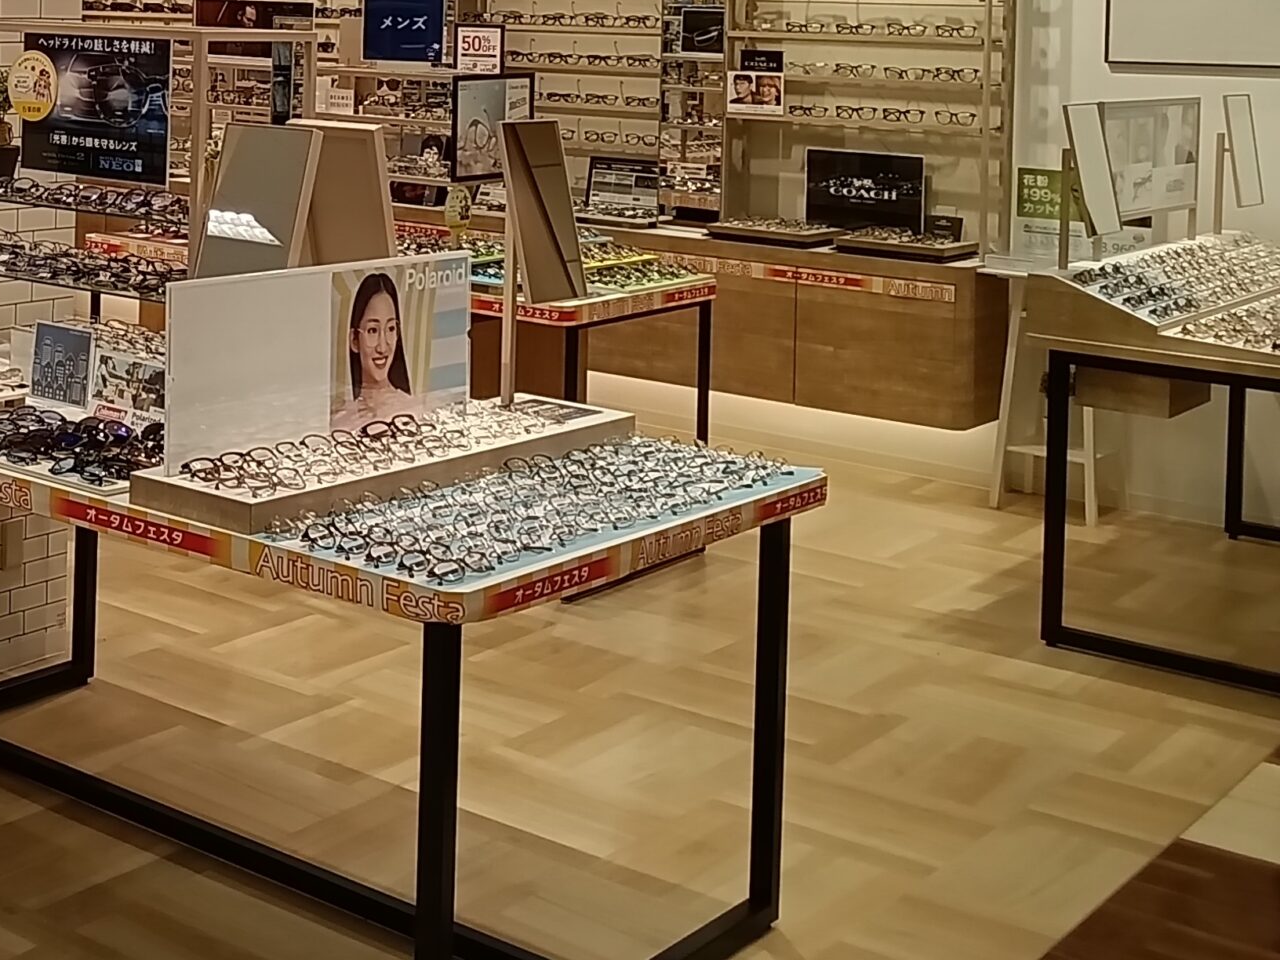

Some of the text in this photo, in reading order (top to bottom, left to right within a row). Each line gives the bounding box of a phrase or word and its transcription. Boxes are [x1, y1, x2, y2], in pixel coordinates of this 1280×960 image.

[380, 16, 428, 30] メンズ
[481, 45, 497, 53] OFF
[99, 159, 134, 171] NEO
[1023, 174, 1048, 187] 花粉
[829, 186, 898, 201] COACH
[405, 263, 466, 292] Polaroid
[887, 280, 953, 301] Autumn
[95, 405, 122, 420] Coleman
[85, 506, 183, 545] オータムフェスタ
[637, 512, 742, 567] Autumn Festa
[256, 544, 466, 623] Autumn Festa
[514, 565, 589, 604] オータムフェスタ
